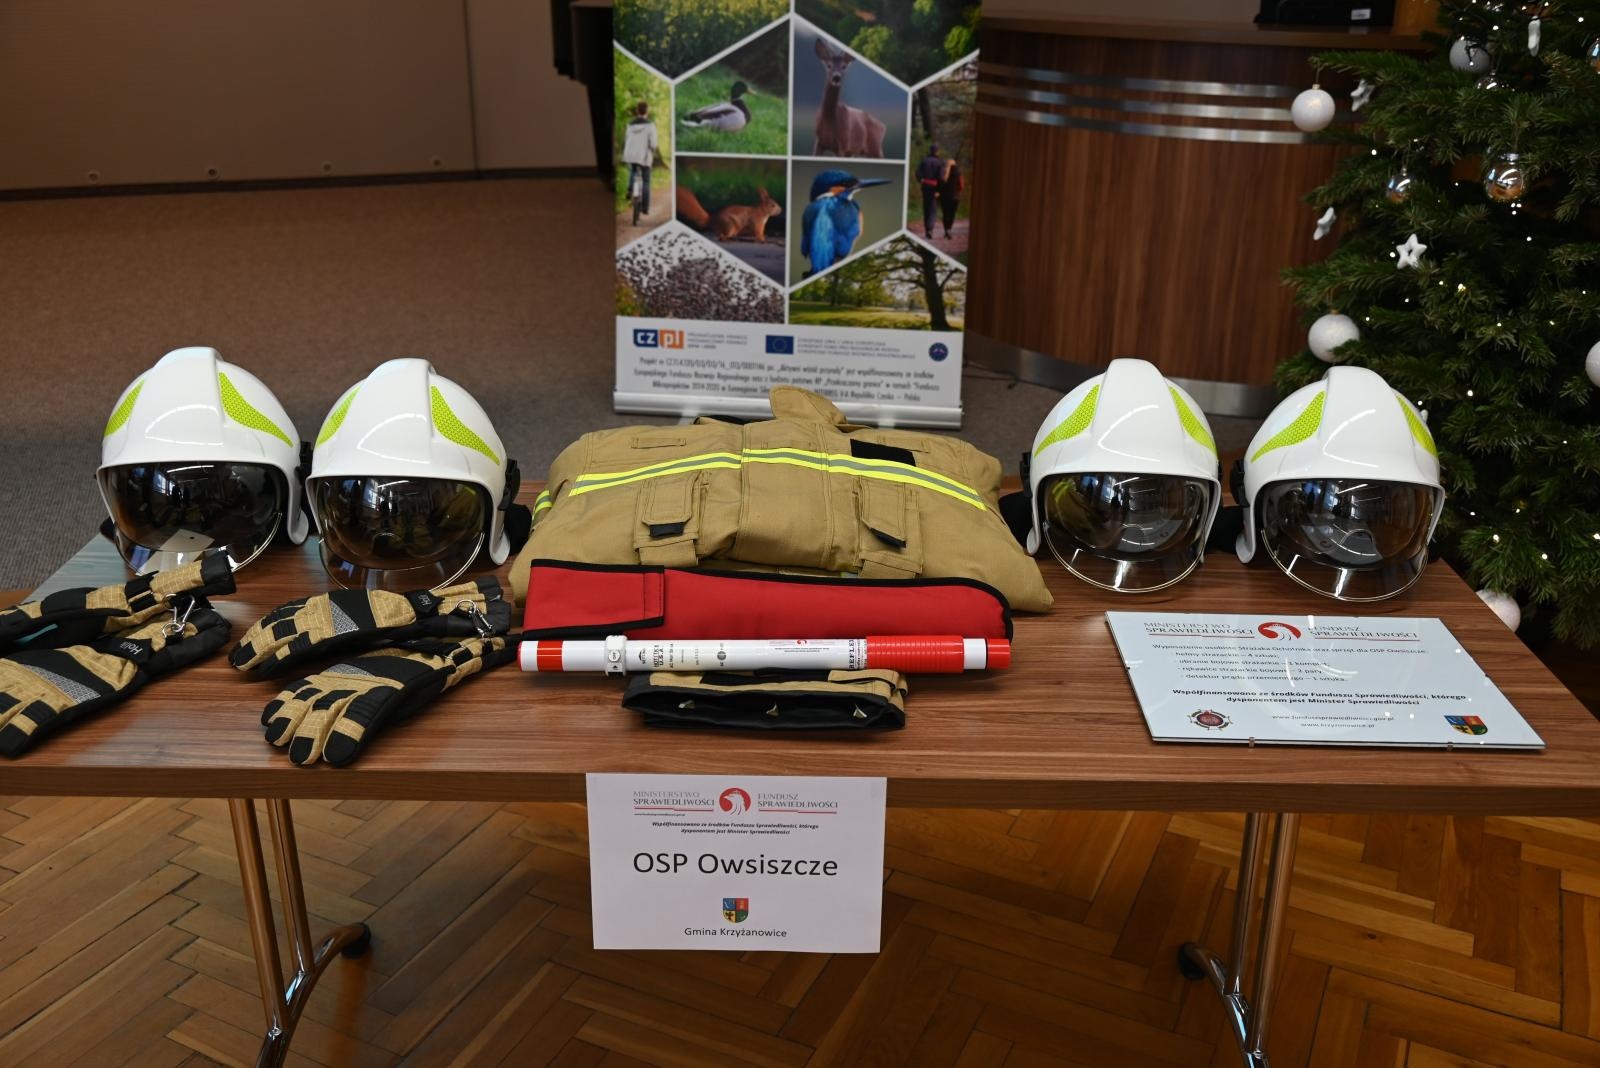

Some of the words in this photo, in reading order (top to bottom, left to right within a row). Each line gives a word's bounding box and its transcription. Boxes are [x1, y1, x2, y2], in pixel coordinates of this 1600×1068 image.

[636, 332, 656, 344] cz
[664, 330, 680, 349] pl
[1145, 627, 1253, 635] SPRAWIEDLIWOŚCI
[1172, 689, 1256, 697] Współfinansowano
[633, 790, 701, 798] MINISTERSTWO
[758, 792, 799, 801] FUNDUSZ
[633, 797, 715, 806] SPRAWIEDLIWOŚCI
[758, 800, 839, 809] SPRAWIEDLIWOŚCI
[633, 852, 688, 874] OSP
[697, 853, 839, 876] Owsiszcze
[684, 927, 717, 937] Gmina
[720, 927, 788, 939] Krzyżanowice
